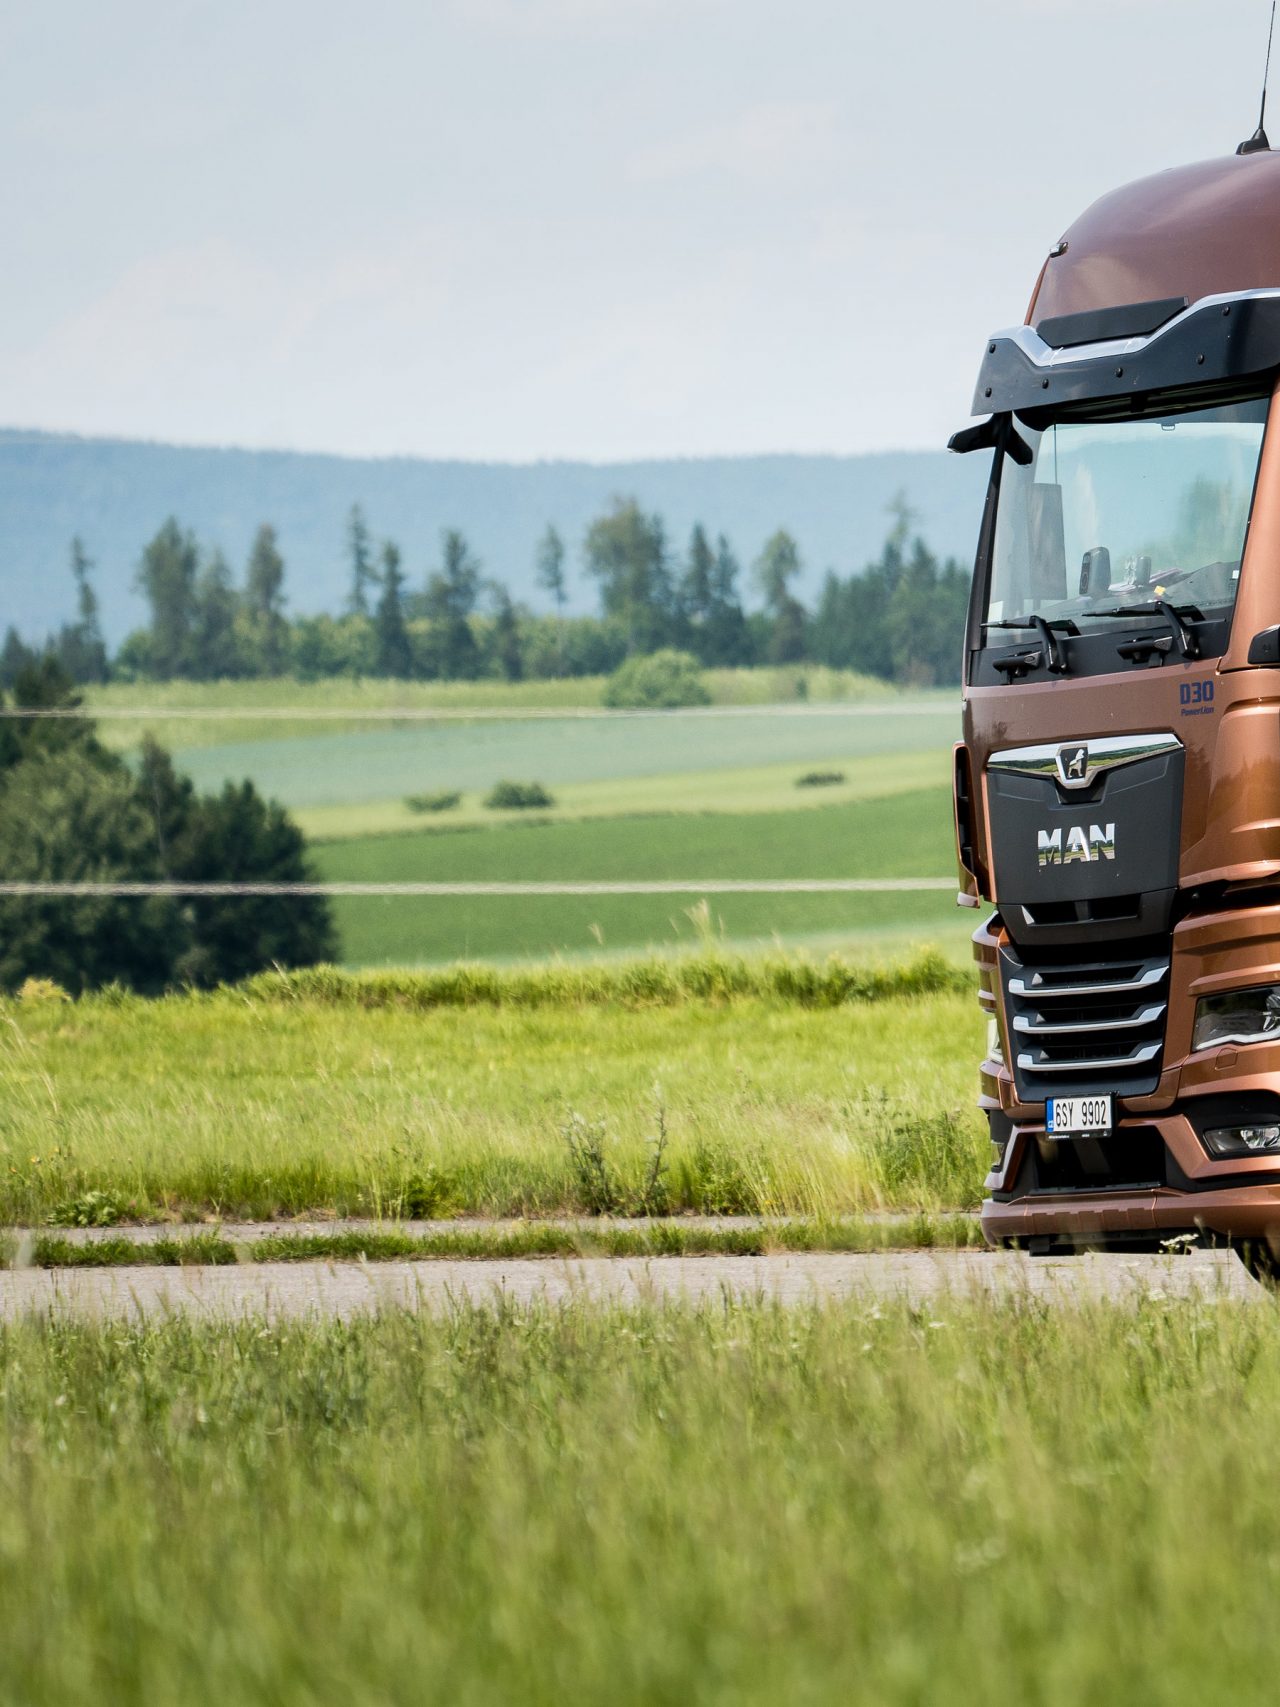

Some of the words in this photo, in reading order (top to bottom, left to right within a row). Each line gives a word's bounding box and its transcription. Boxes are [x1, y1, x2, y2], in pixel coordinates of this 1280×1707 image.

[1180, 680, 1214, 704] D30
[1037, 823, 1116, 866] MAN
[1055, 1102, 1074, 1127] 6SY
[1081, 1100, 1107, 1126] 9902
